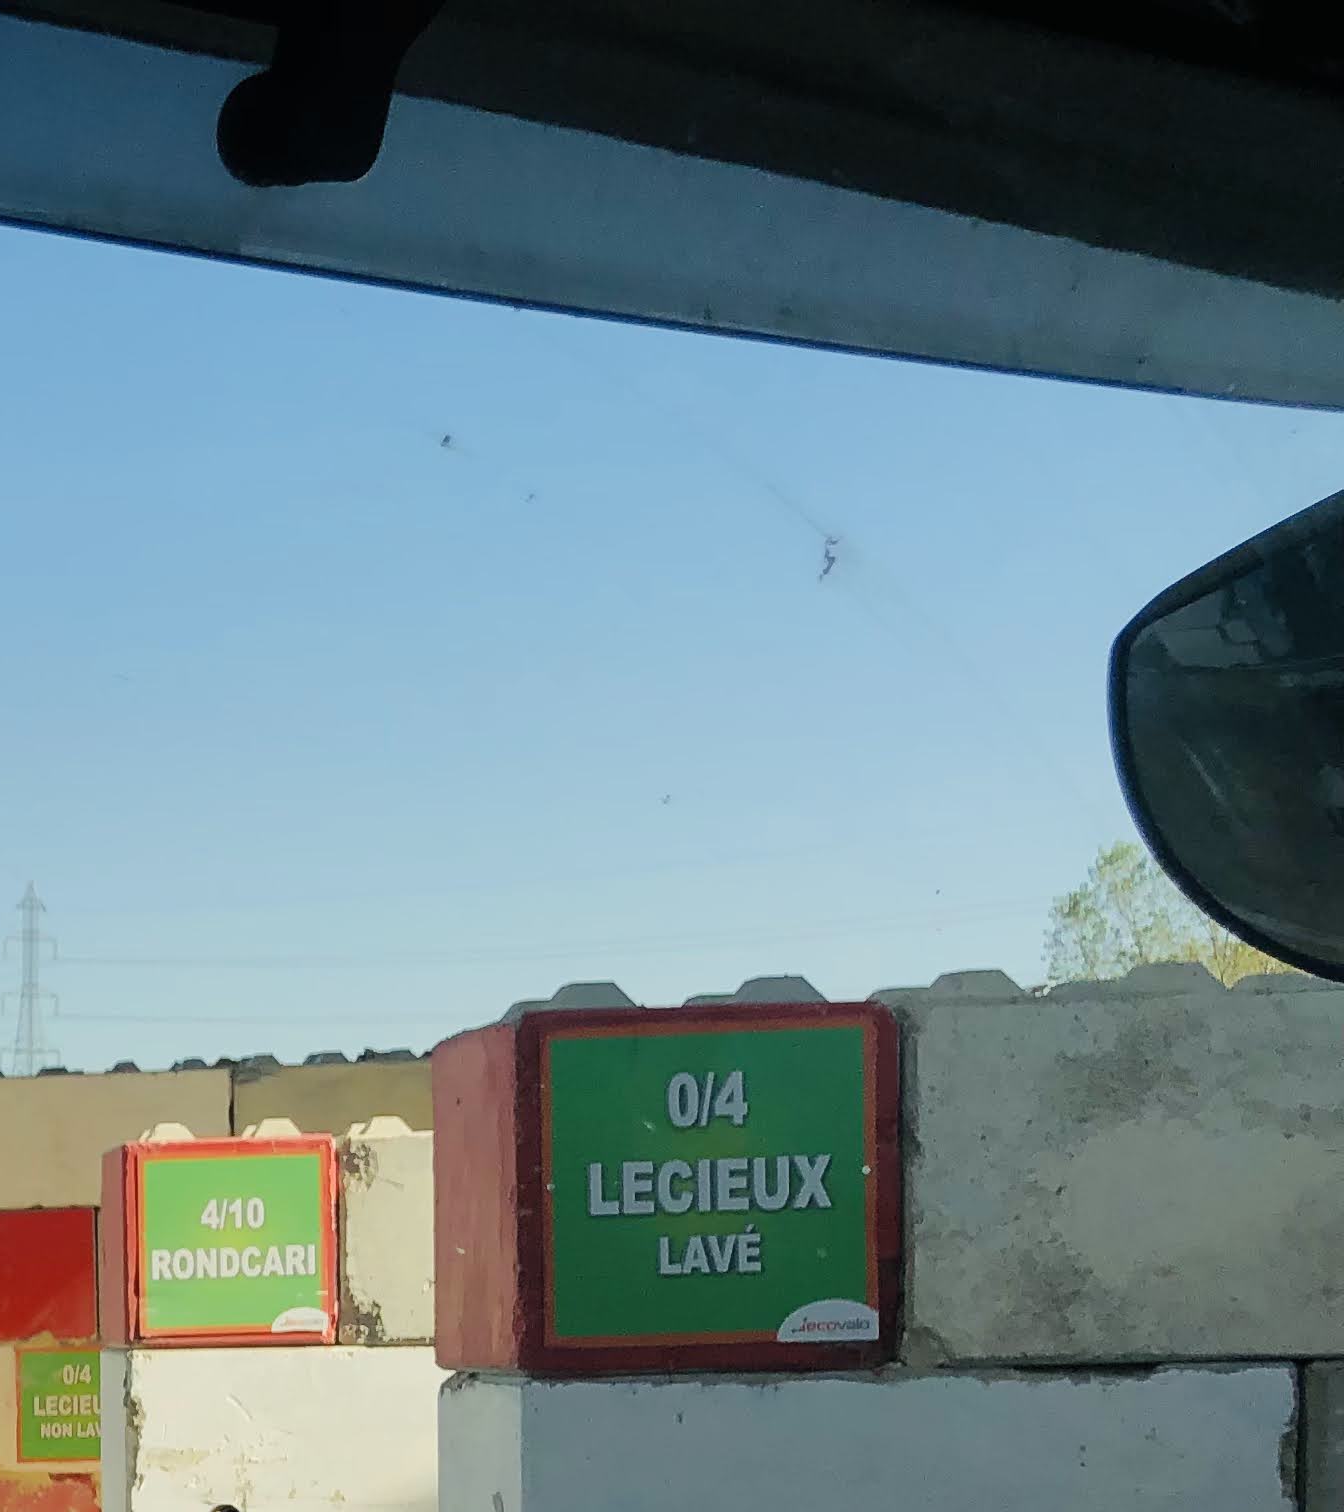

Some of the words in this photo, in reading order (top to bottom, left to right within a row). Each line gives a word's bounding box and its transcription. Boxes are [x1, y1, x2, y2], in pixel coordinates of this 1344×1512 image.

[667, 1070, 748, 1128] 0/4
[587, 1153, 832, 1216] LECIEUX
[200, 1197, 265, 1230] 4/10
[151, 1244, 316, 1280] RONDCARI
[659, 1225, 762, 1275] LAVÉ
[62, 1364, 92, 1385] 0/4
[33, 1394, 101, 1417] LECIEU
[40, 1422, 73, 1439] NON
